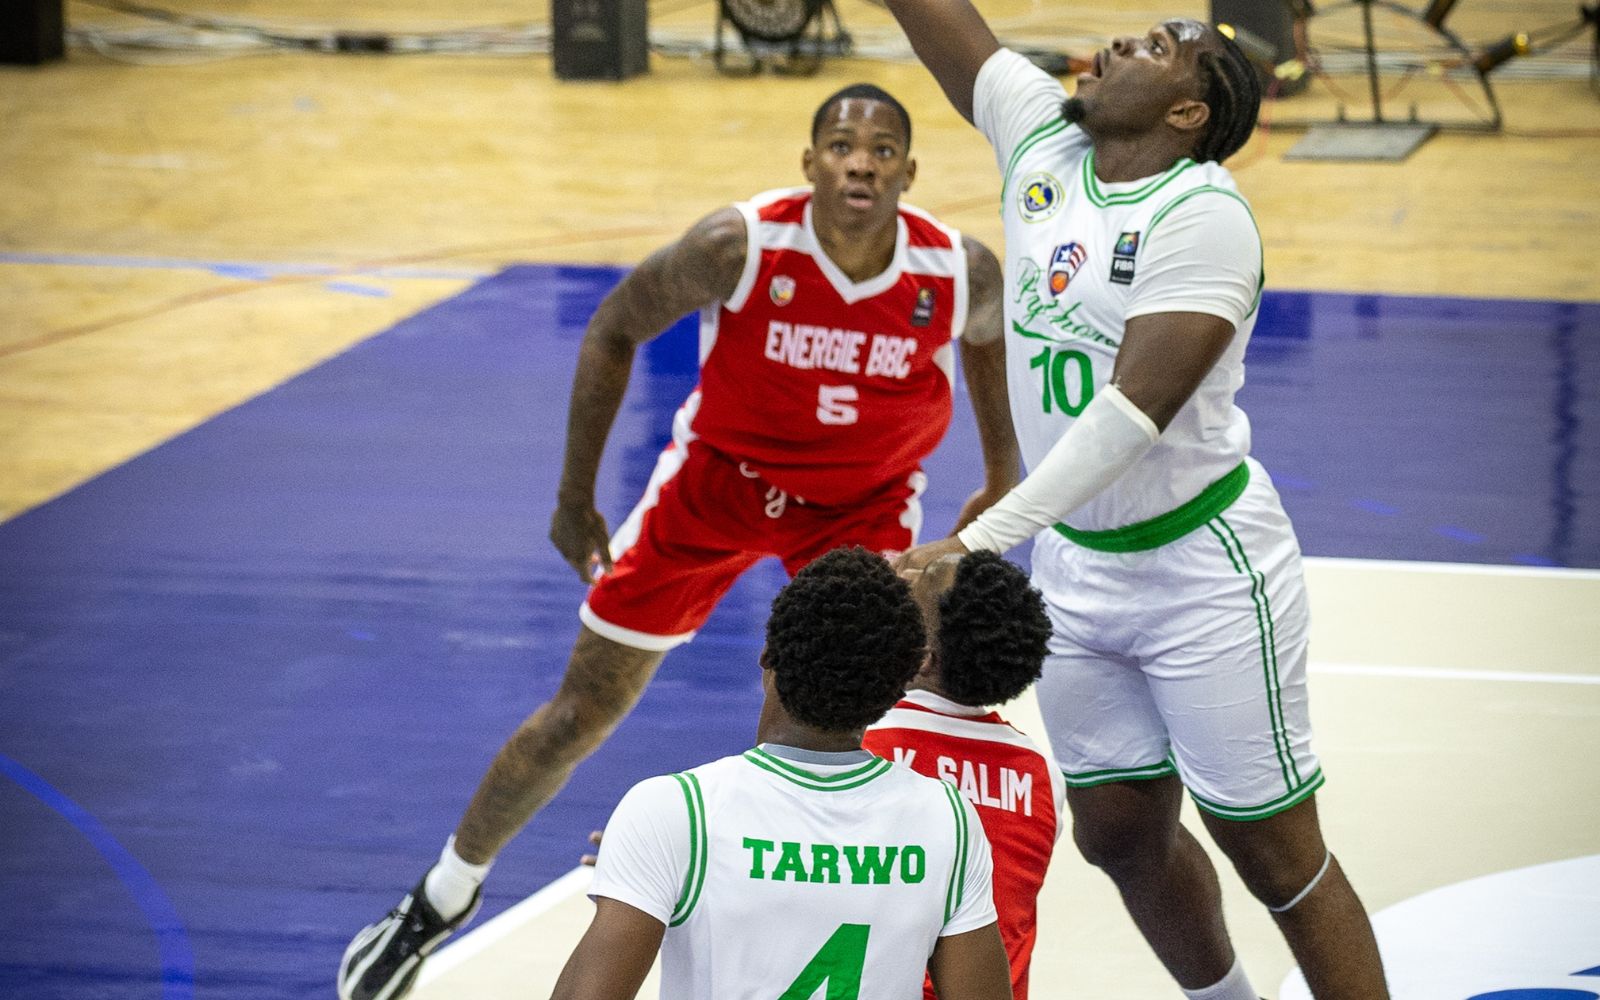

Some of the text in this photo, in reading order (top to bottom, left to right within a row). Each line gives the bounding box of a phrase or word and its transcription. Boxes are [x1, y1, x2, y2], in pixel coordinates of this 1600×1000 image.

[1113, 259, 1135, 272] FIBA
[764, 320, 918, 379] ENERGIE BBC
[816, 384, 859, 425] 5
[1029, 346, 1095, 417] 10
[937, 756, 1033, 816] SALIM
[742, 837, 926, 885] TARWO
[776, 922, 871, 1000] 4
